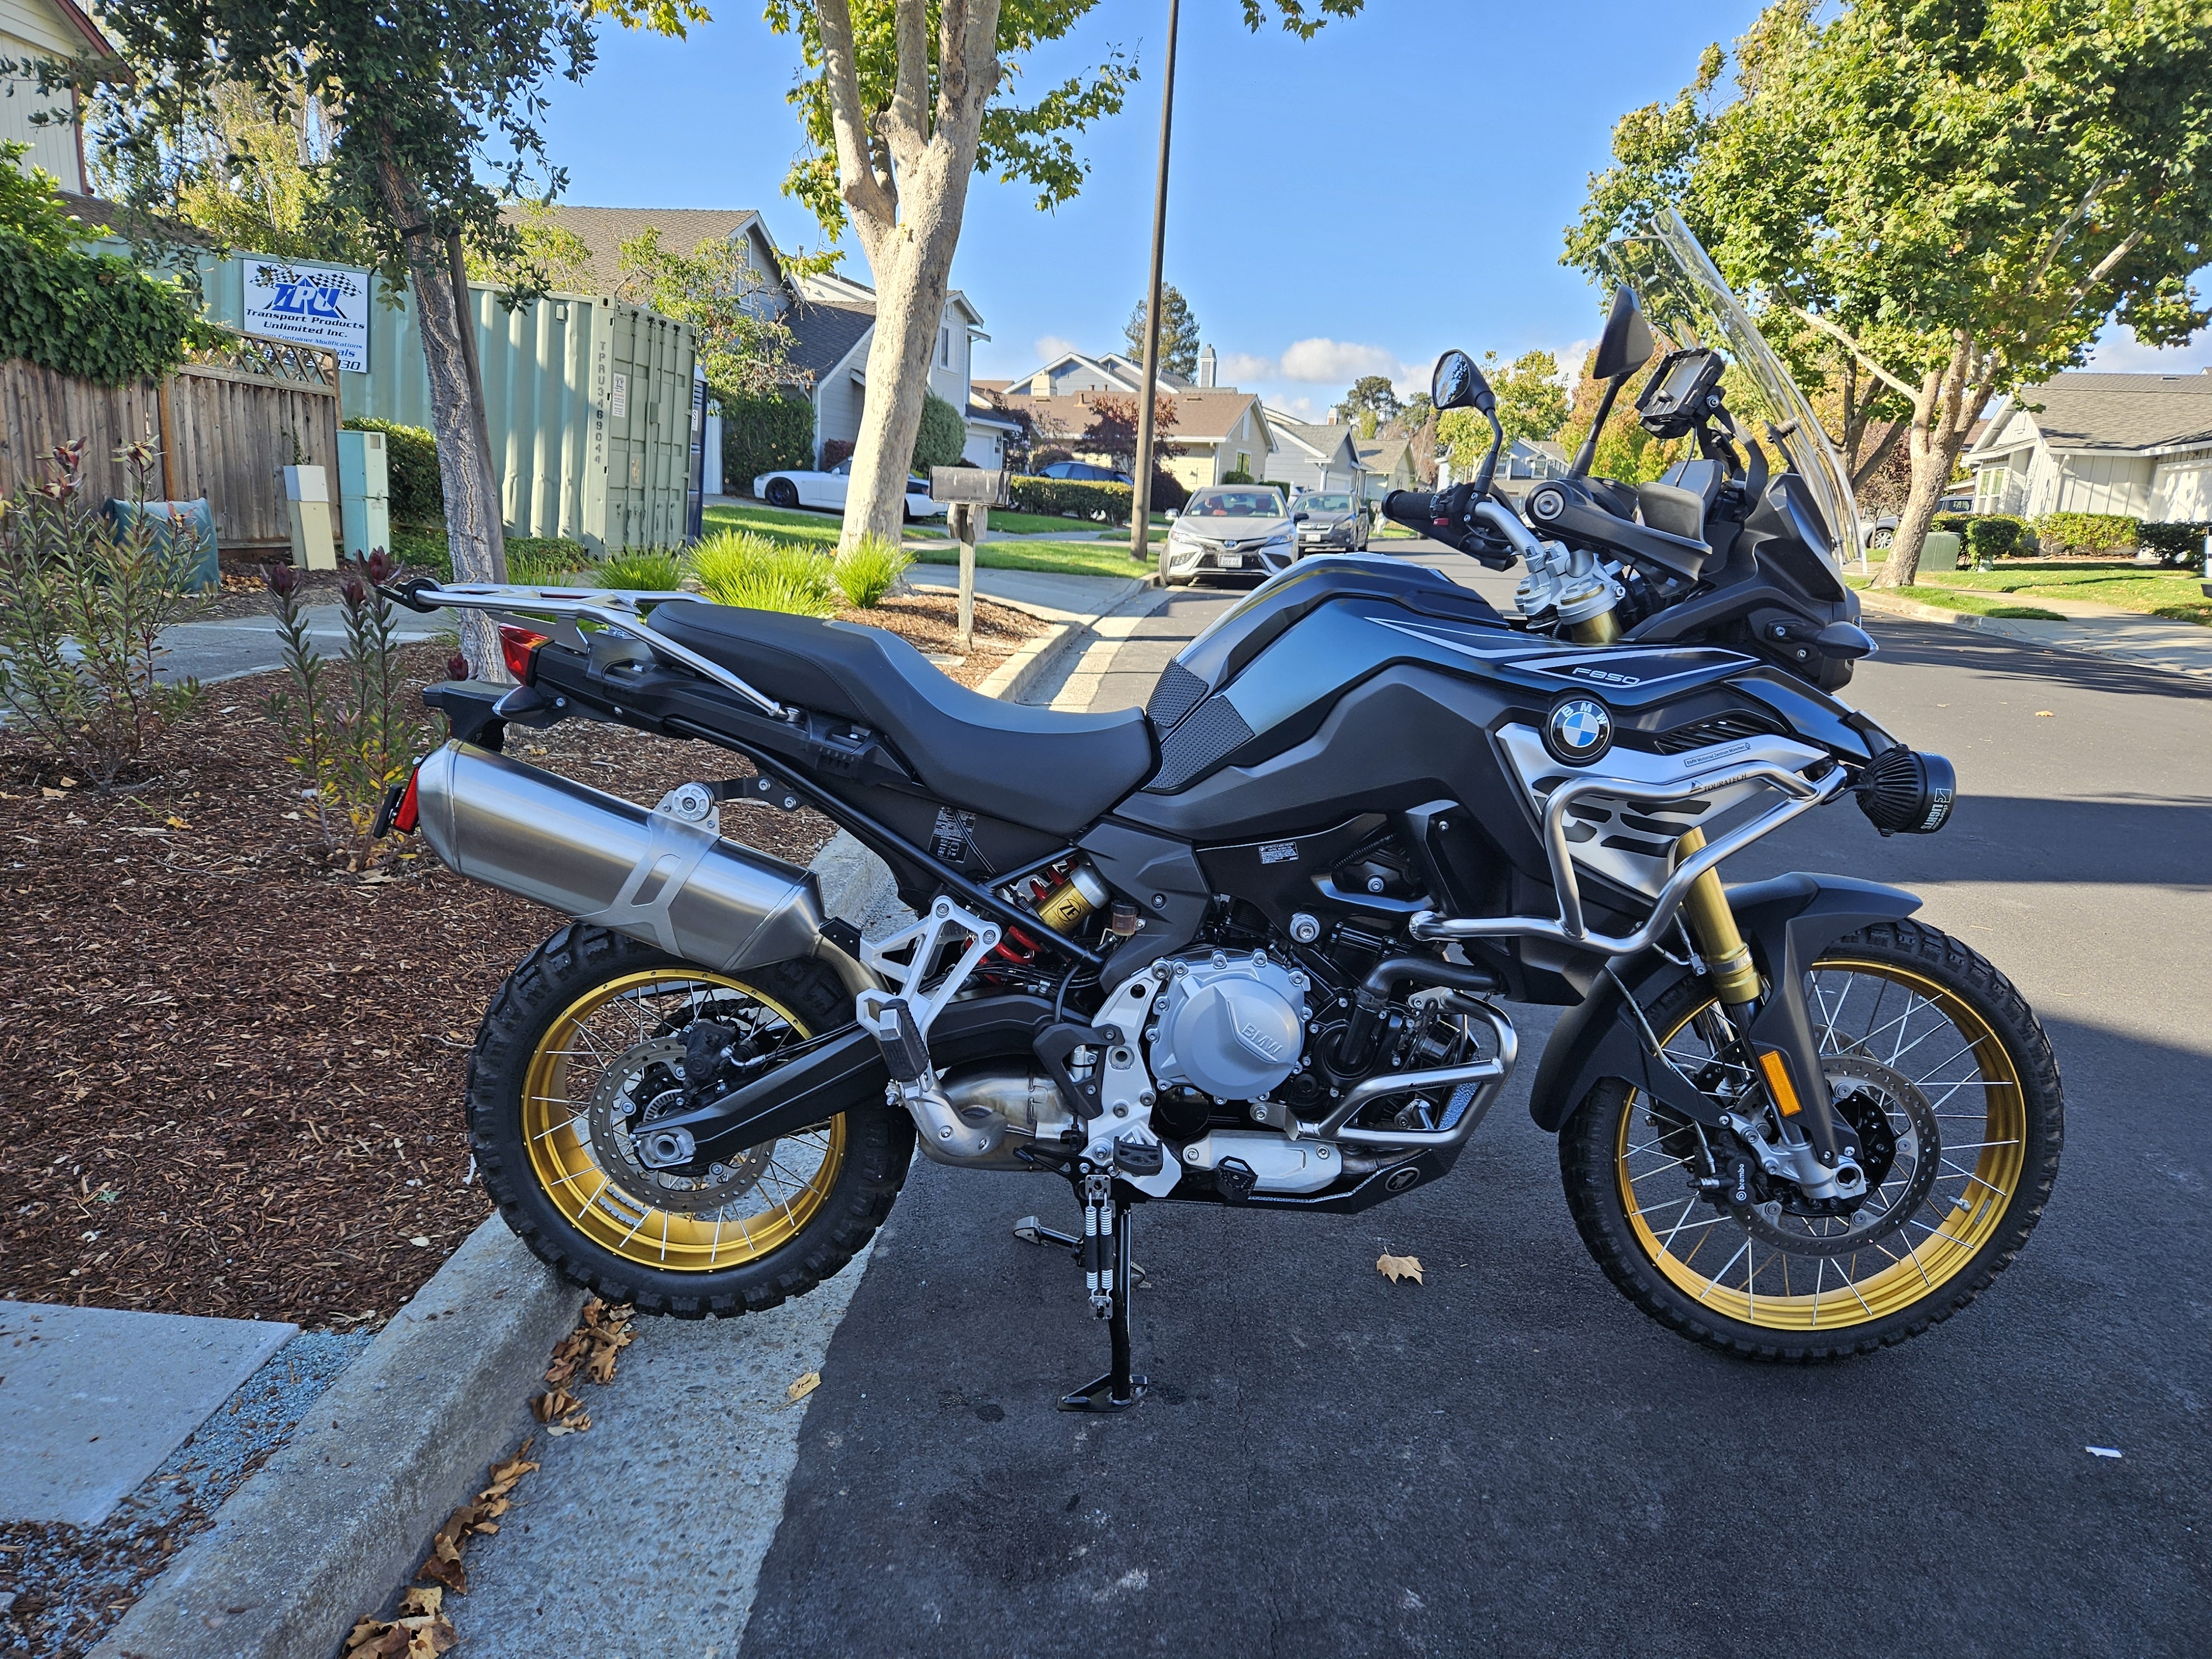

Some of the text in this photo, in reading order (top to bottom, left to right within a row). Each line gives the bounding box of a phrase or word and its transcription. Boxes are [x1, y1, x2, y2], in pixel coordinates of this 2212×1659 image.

[246, 309, 365, 329] Transport Products
[264, 321, 323, 334] Unlimited
[315, 339, 362, 348] Modifications
[1572, 667, 1640, 685] F850
[1561, 702, 1608, 725] BMW
[1704, 773, 1746, 792] TOURATECH
[1921, 804, 1943, 830] LIGHTS
[1059, 899, 1080, 921] ZF
[1241, 1022, 1283, 1055] BMW
